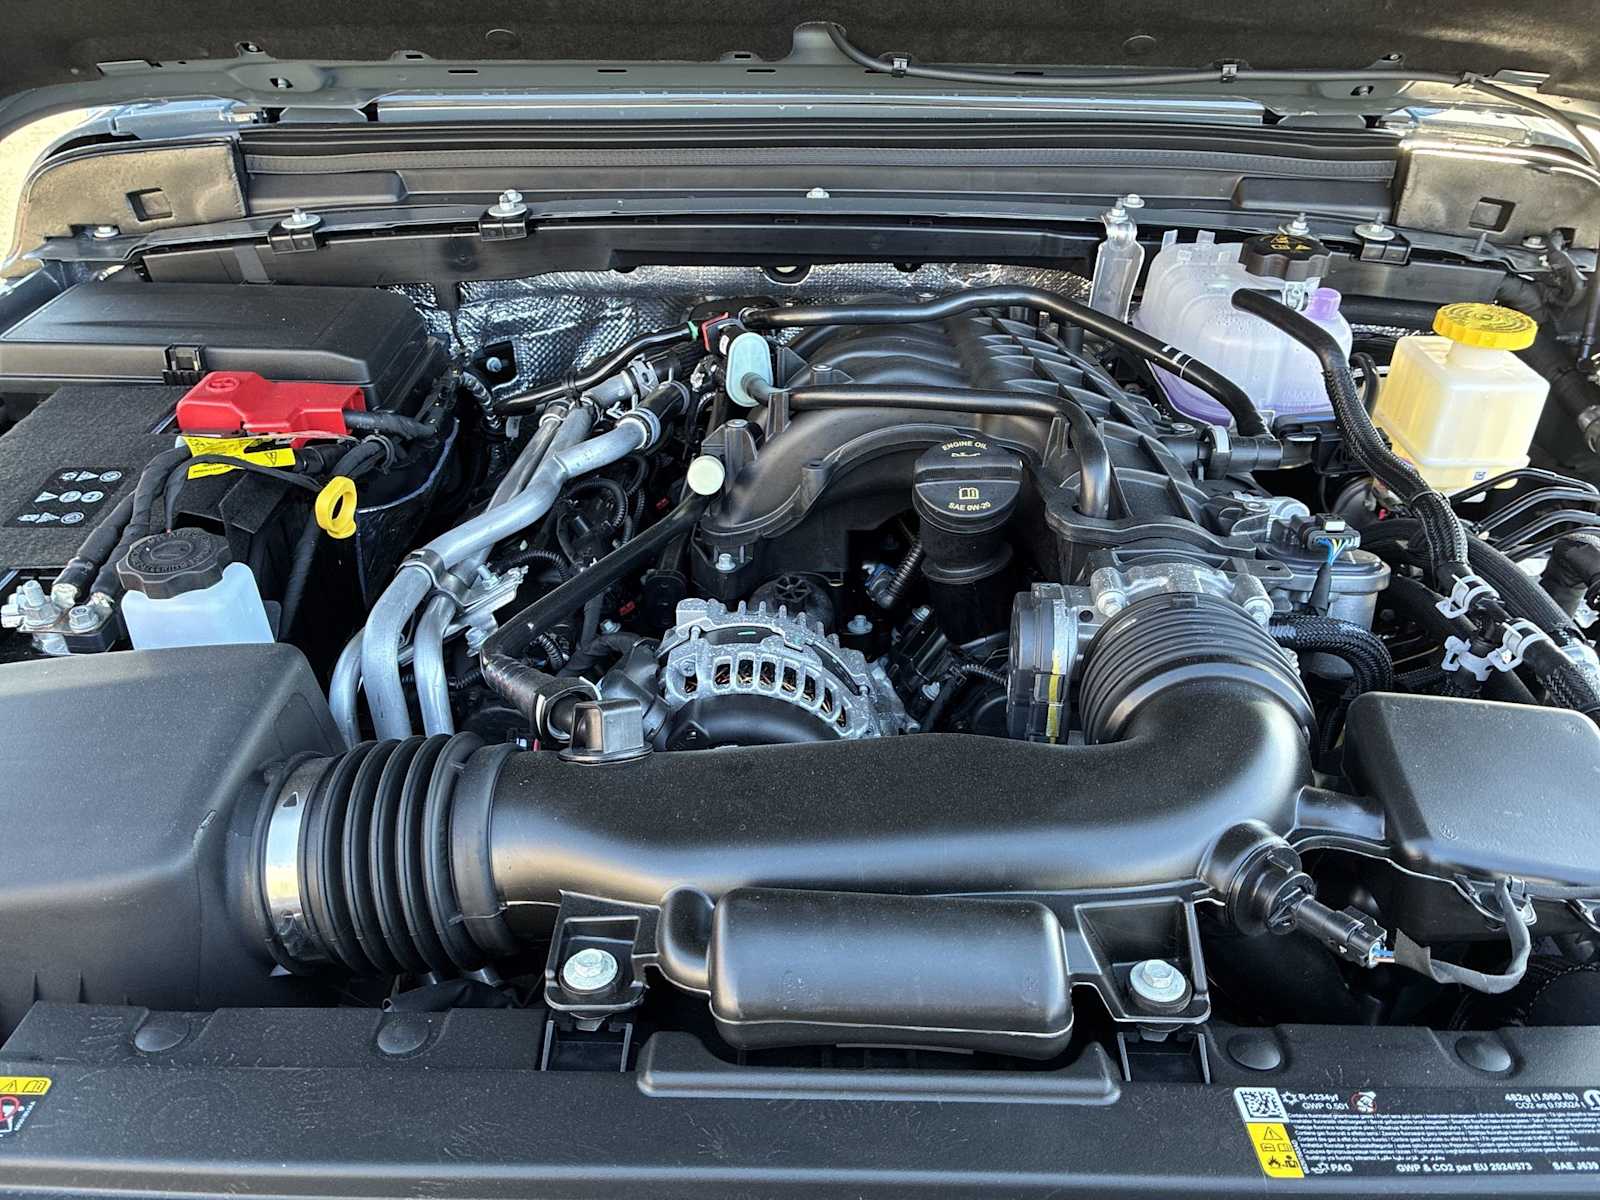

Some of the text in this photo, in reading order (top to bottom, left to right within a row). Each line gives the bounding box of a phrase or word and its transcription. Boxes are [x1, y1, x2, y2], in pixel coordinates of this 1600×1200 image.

[942, 441, 988, 451] ENGINE OIL
[948, 501, 991, 511] SAE 0W-20
[1302, 1102, 1325, 1110] GWP
[1515, 1101, 1536, 1109] CO2
[1330, 1163, 1353, 1172] PAG
[1396, 1163, 1421, 1172] GWP
[1422, 1163, 1432, 1172] &
[1432, 1162, 1455, 1172] CO2
[1456, 1164, 1472, 1173] per
[1472, 1162, 1489, 1171] EU
[1552, 1161, 1575, 1170] SAE
